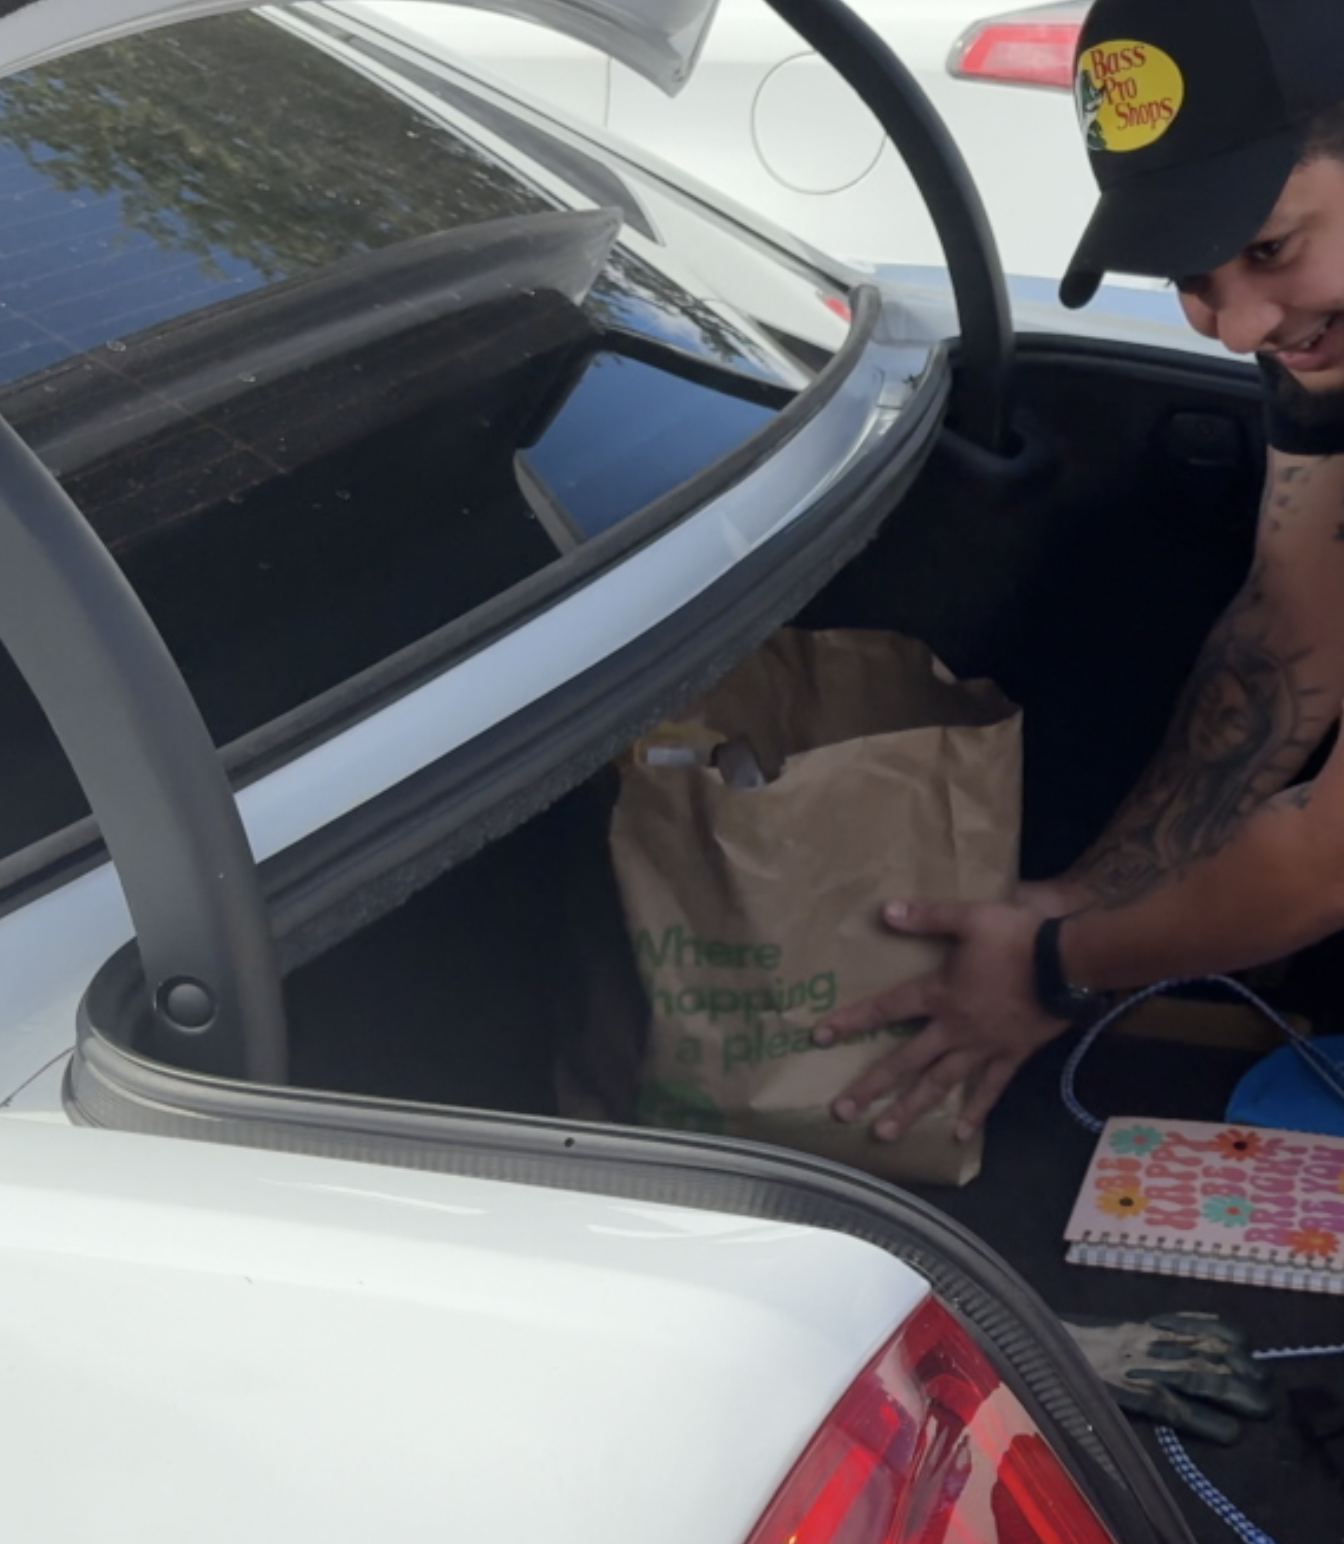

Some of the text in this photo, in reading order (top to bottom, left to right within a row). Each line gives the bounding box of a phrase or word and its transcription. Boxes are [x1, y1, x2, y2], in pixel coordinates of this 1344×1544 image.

[1090, 45, 1146, 80] Bass
[1103, 77, 1137, 105] Pro
[1115, 97, 1174, 130] Shops
[652, 970, 837, 1023] hopping
[676, 1036, 702, 1065] a
[1094, 1157, 1142, 1192] BE
[1144, 1131, 1217, 1230] HAPPY
[1200, 1165, 1248, 1197] BE
[1243, 1137, 1309, 1247] BRIGHT
